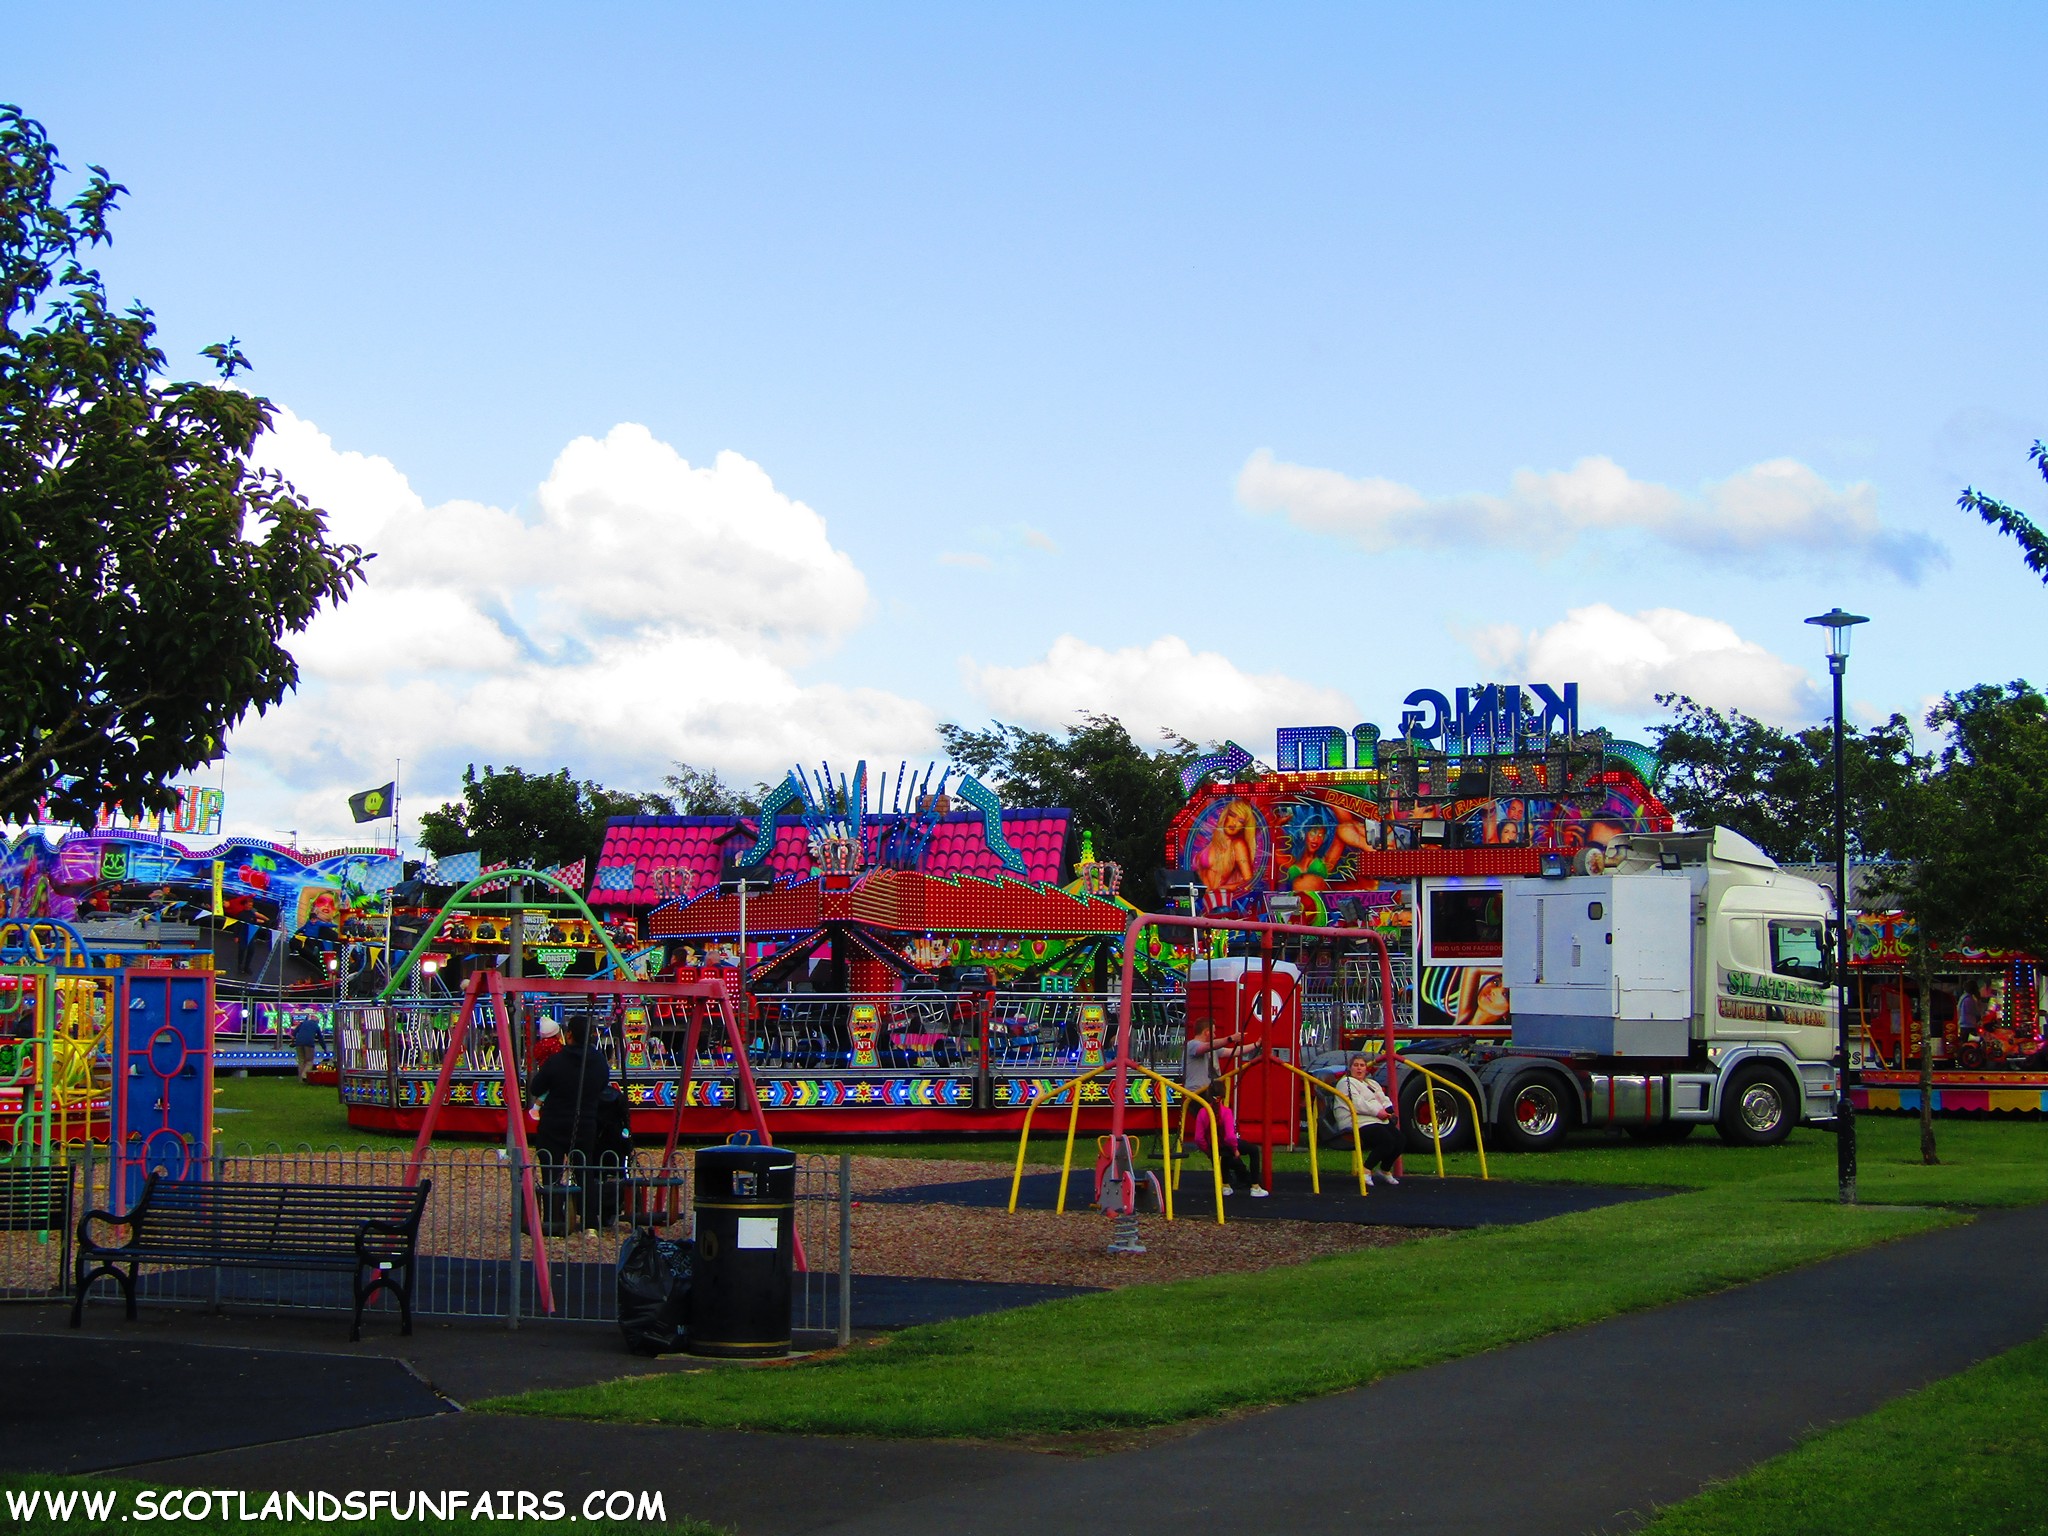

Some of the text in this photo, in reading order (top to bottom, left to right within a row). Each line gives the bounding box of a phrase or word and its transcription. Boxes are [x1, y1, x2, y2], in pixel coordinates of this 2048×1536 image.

[523, 915, 547, 924] ONSTER
[1473, 944, 1503, 952] FACEBOO
[1727, 970, 1824, 1006] SLATERS
